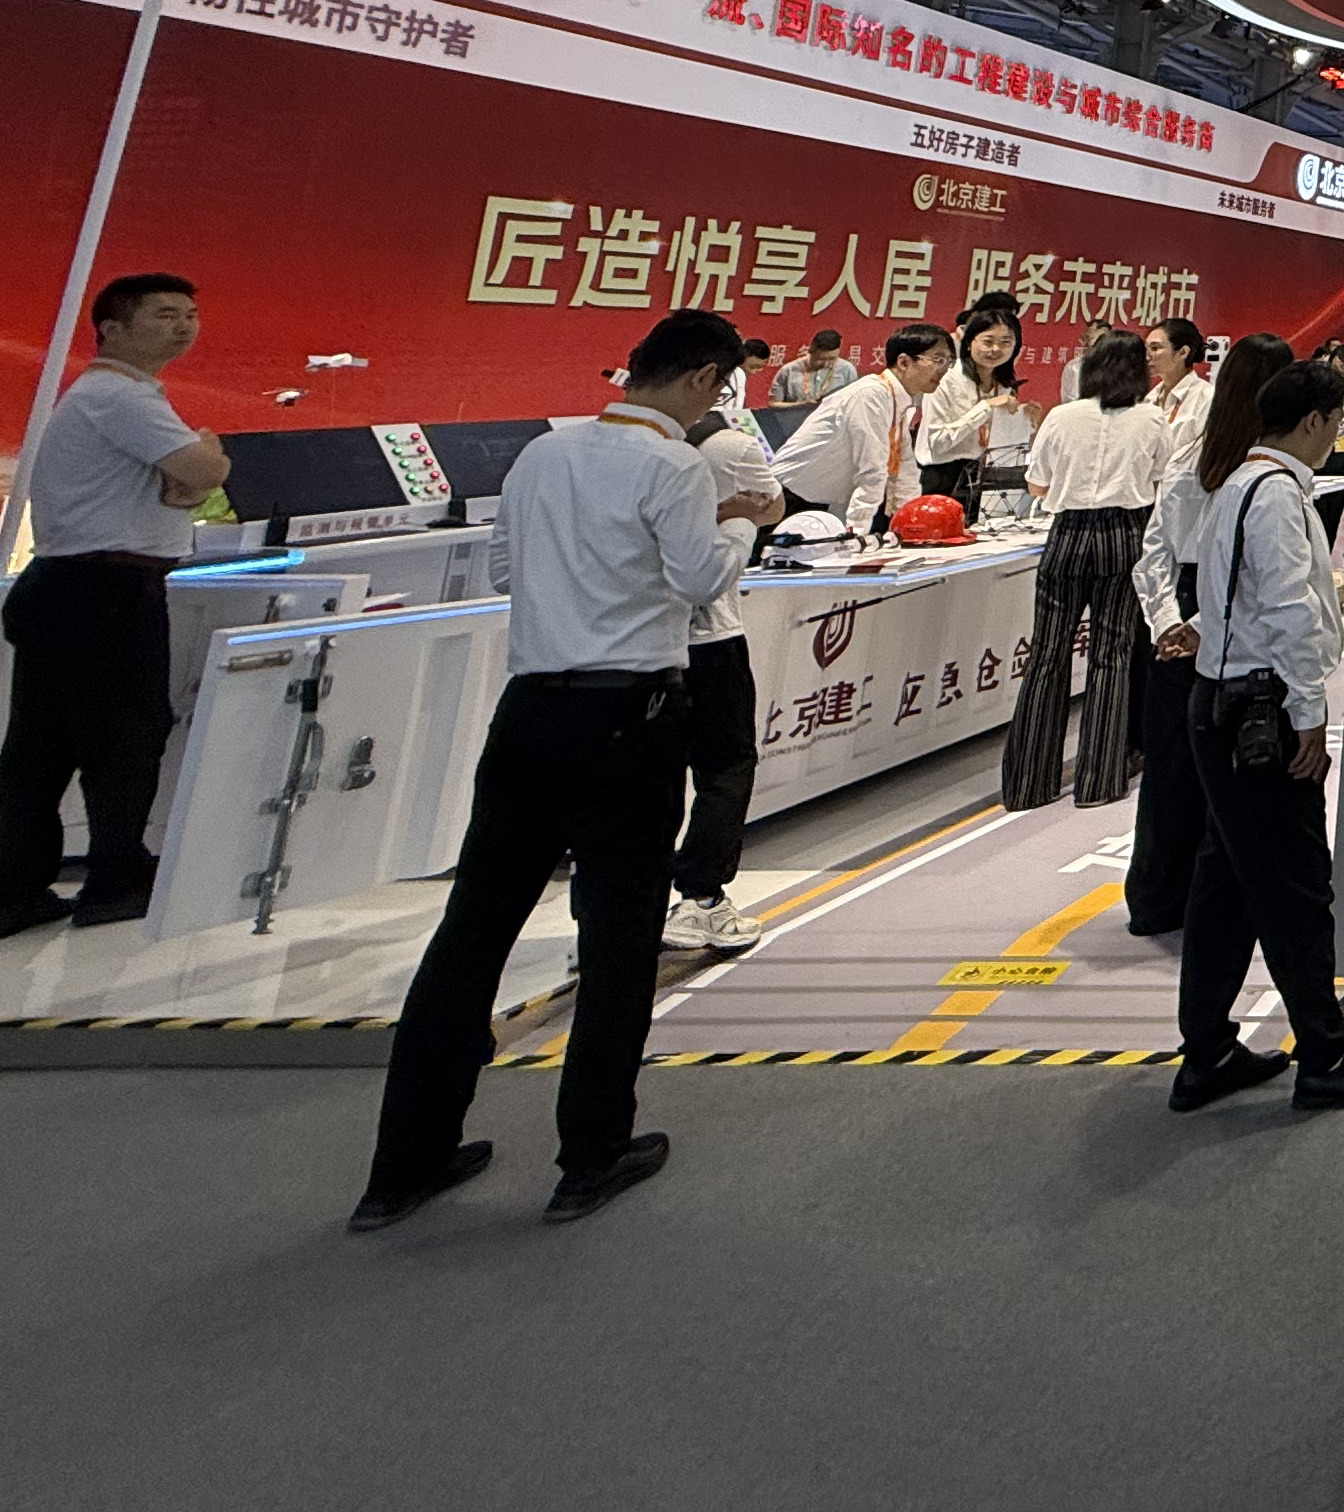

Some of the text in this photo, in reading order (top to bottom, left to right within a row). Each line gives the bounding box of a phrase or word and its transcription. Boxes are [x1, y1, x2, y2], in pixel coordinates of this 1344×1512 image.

[910, 123, 1021, 168] 五好房子建造者
[939, 178, 1006, 214] 北京建工
[467, 195, 1200, 328] 匠造悦享人居 服务未来城市
